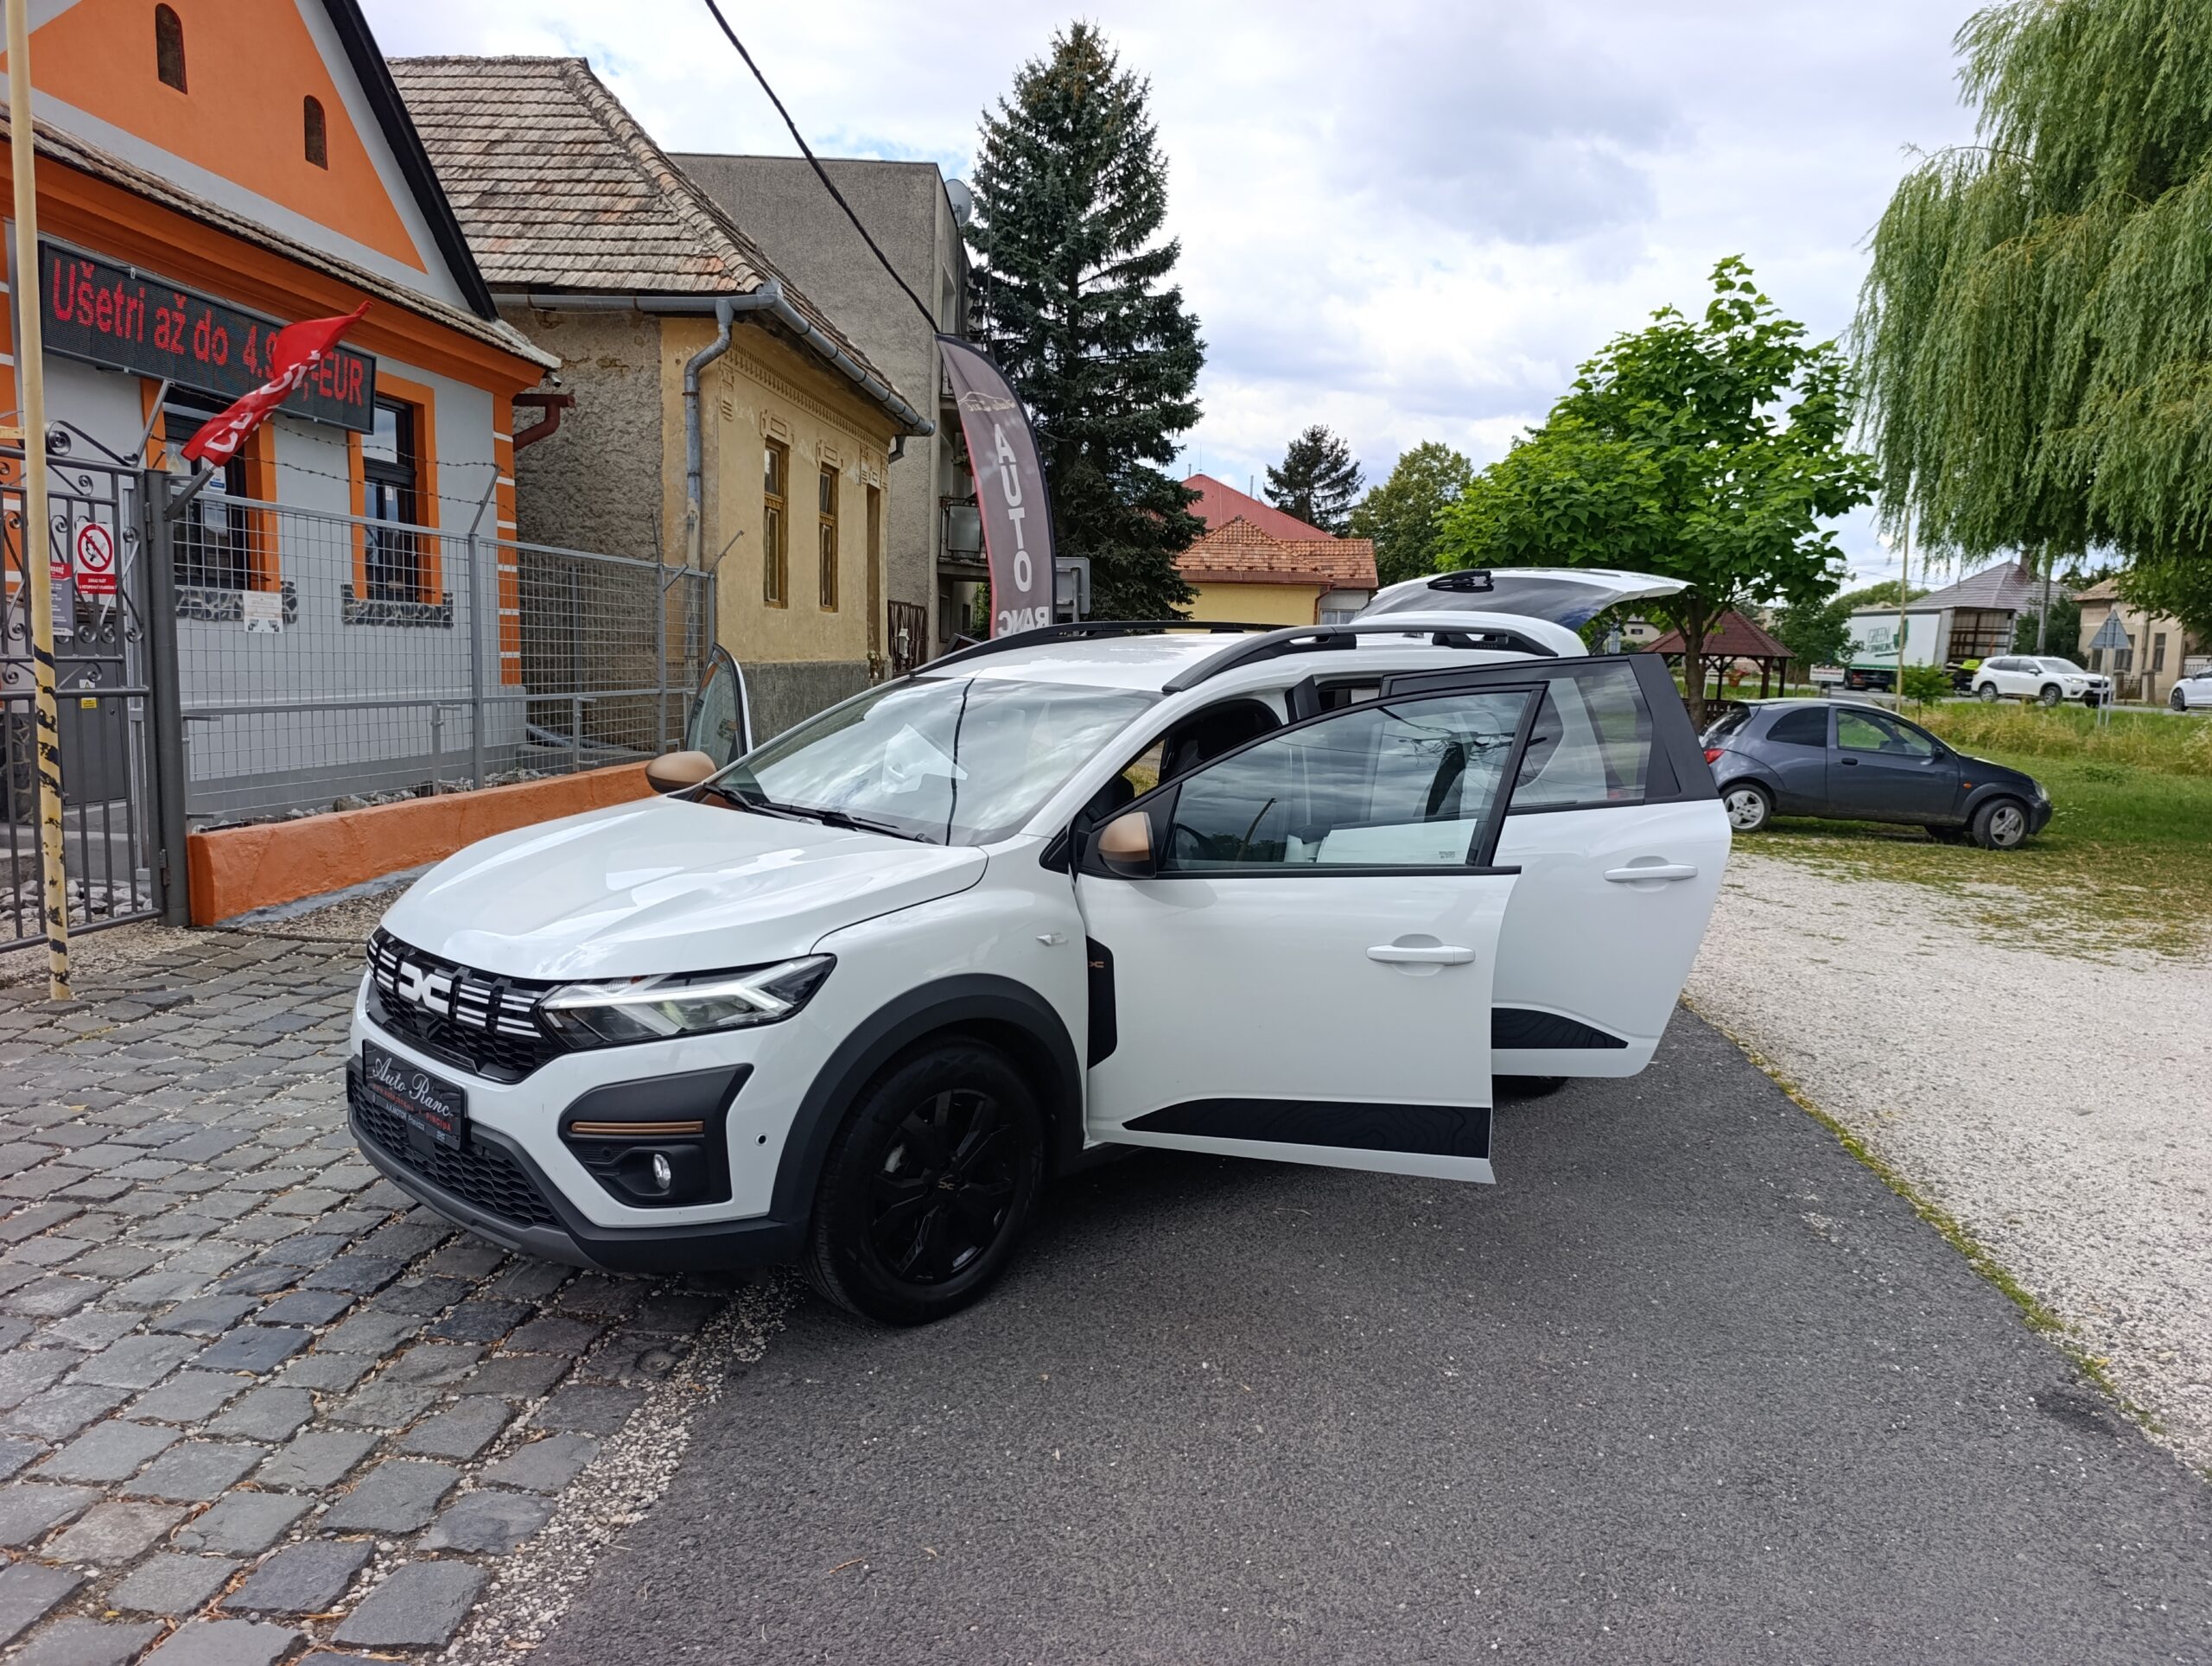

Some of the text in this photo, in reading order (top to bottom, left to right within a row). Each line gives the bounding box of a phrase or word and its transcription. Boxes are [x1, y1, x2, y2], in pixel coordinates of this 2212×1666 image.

[53, 258, 145, 343] Ušetri
[154, 293, 187, 355] až
[194, 308, 228, 366] do
[372, 1057, 407, 1091] Auto
[409, 1073, 454, 1117] Ranc
